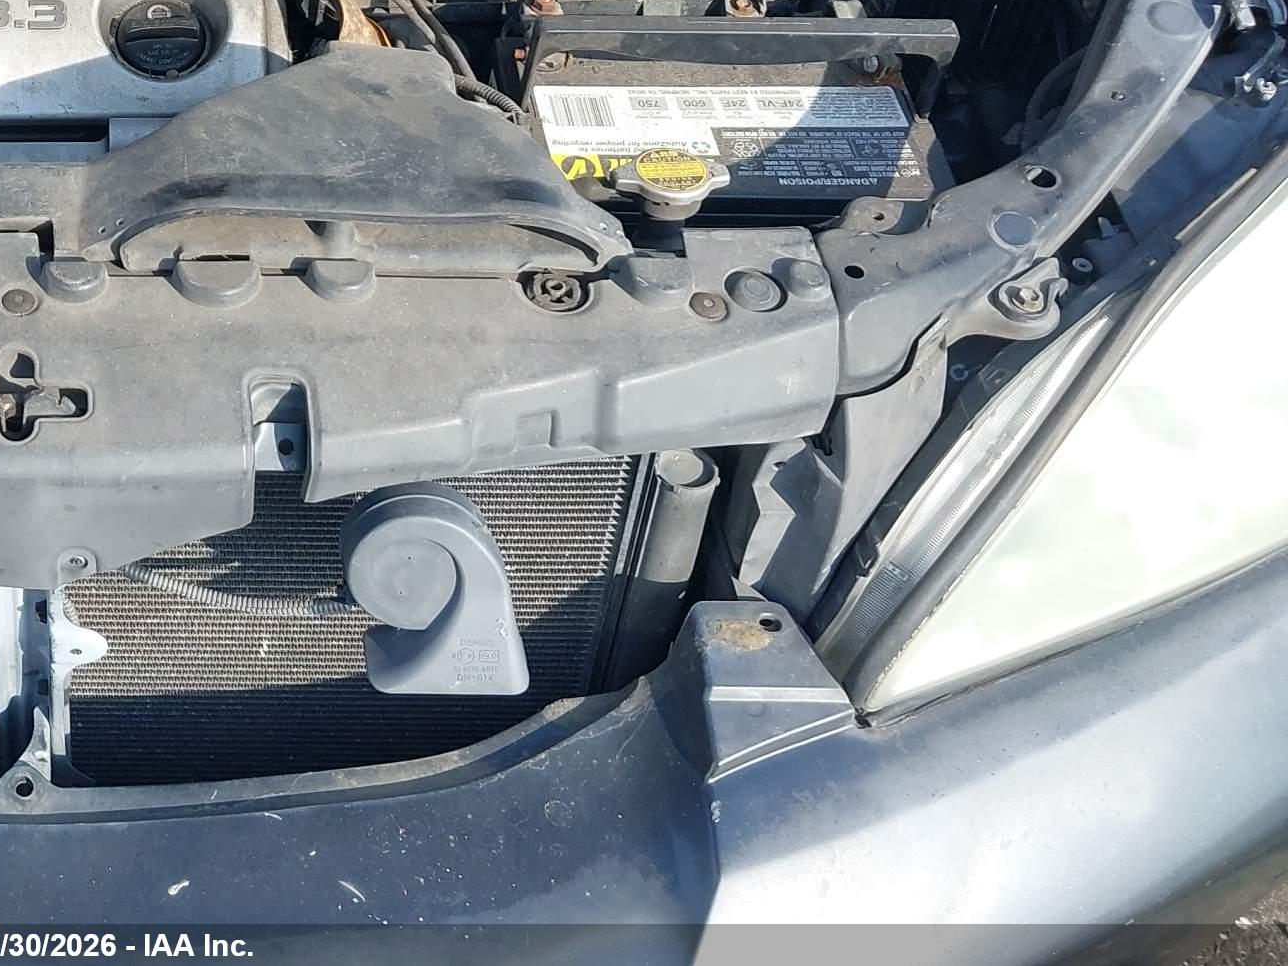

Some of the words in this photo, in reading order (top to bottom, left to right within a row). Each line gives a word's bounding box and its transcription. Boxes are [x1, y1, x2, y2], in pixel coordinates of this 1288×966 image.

[637, 99, 662, 108] 750
[683, 99, 706, 108] 600
[723, 99, 746, 108] 24F
[755, 99, 803, 108] 24F-VL
